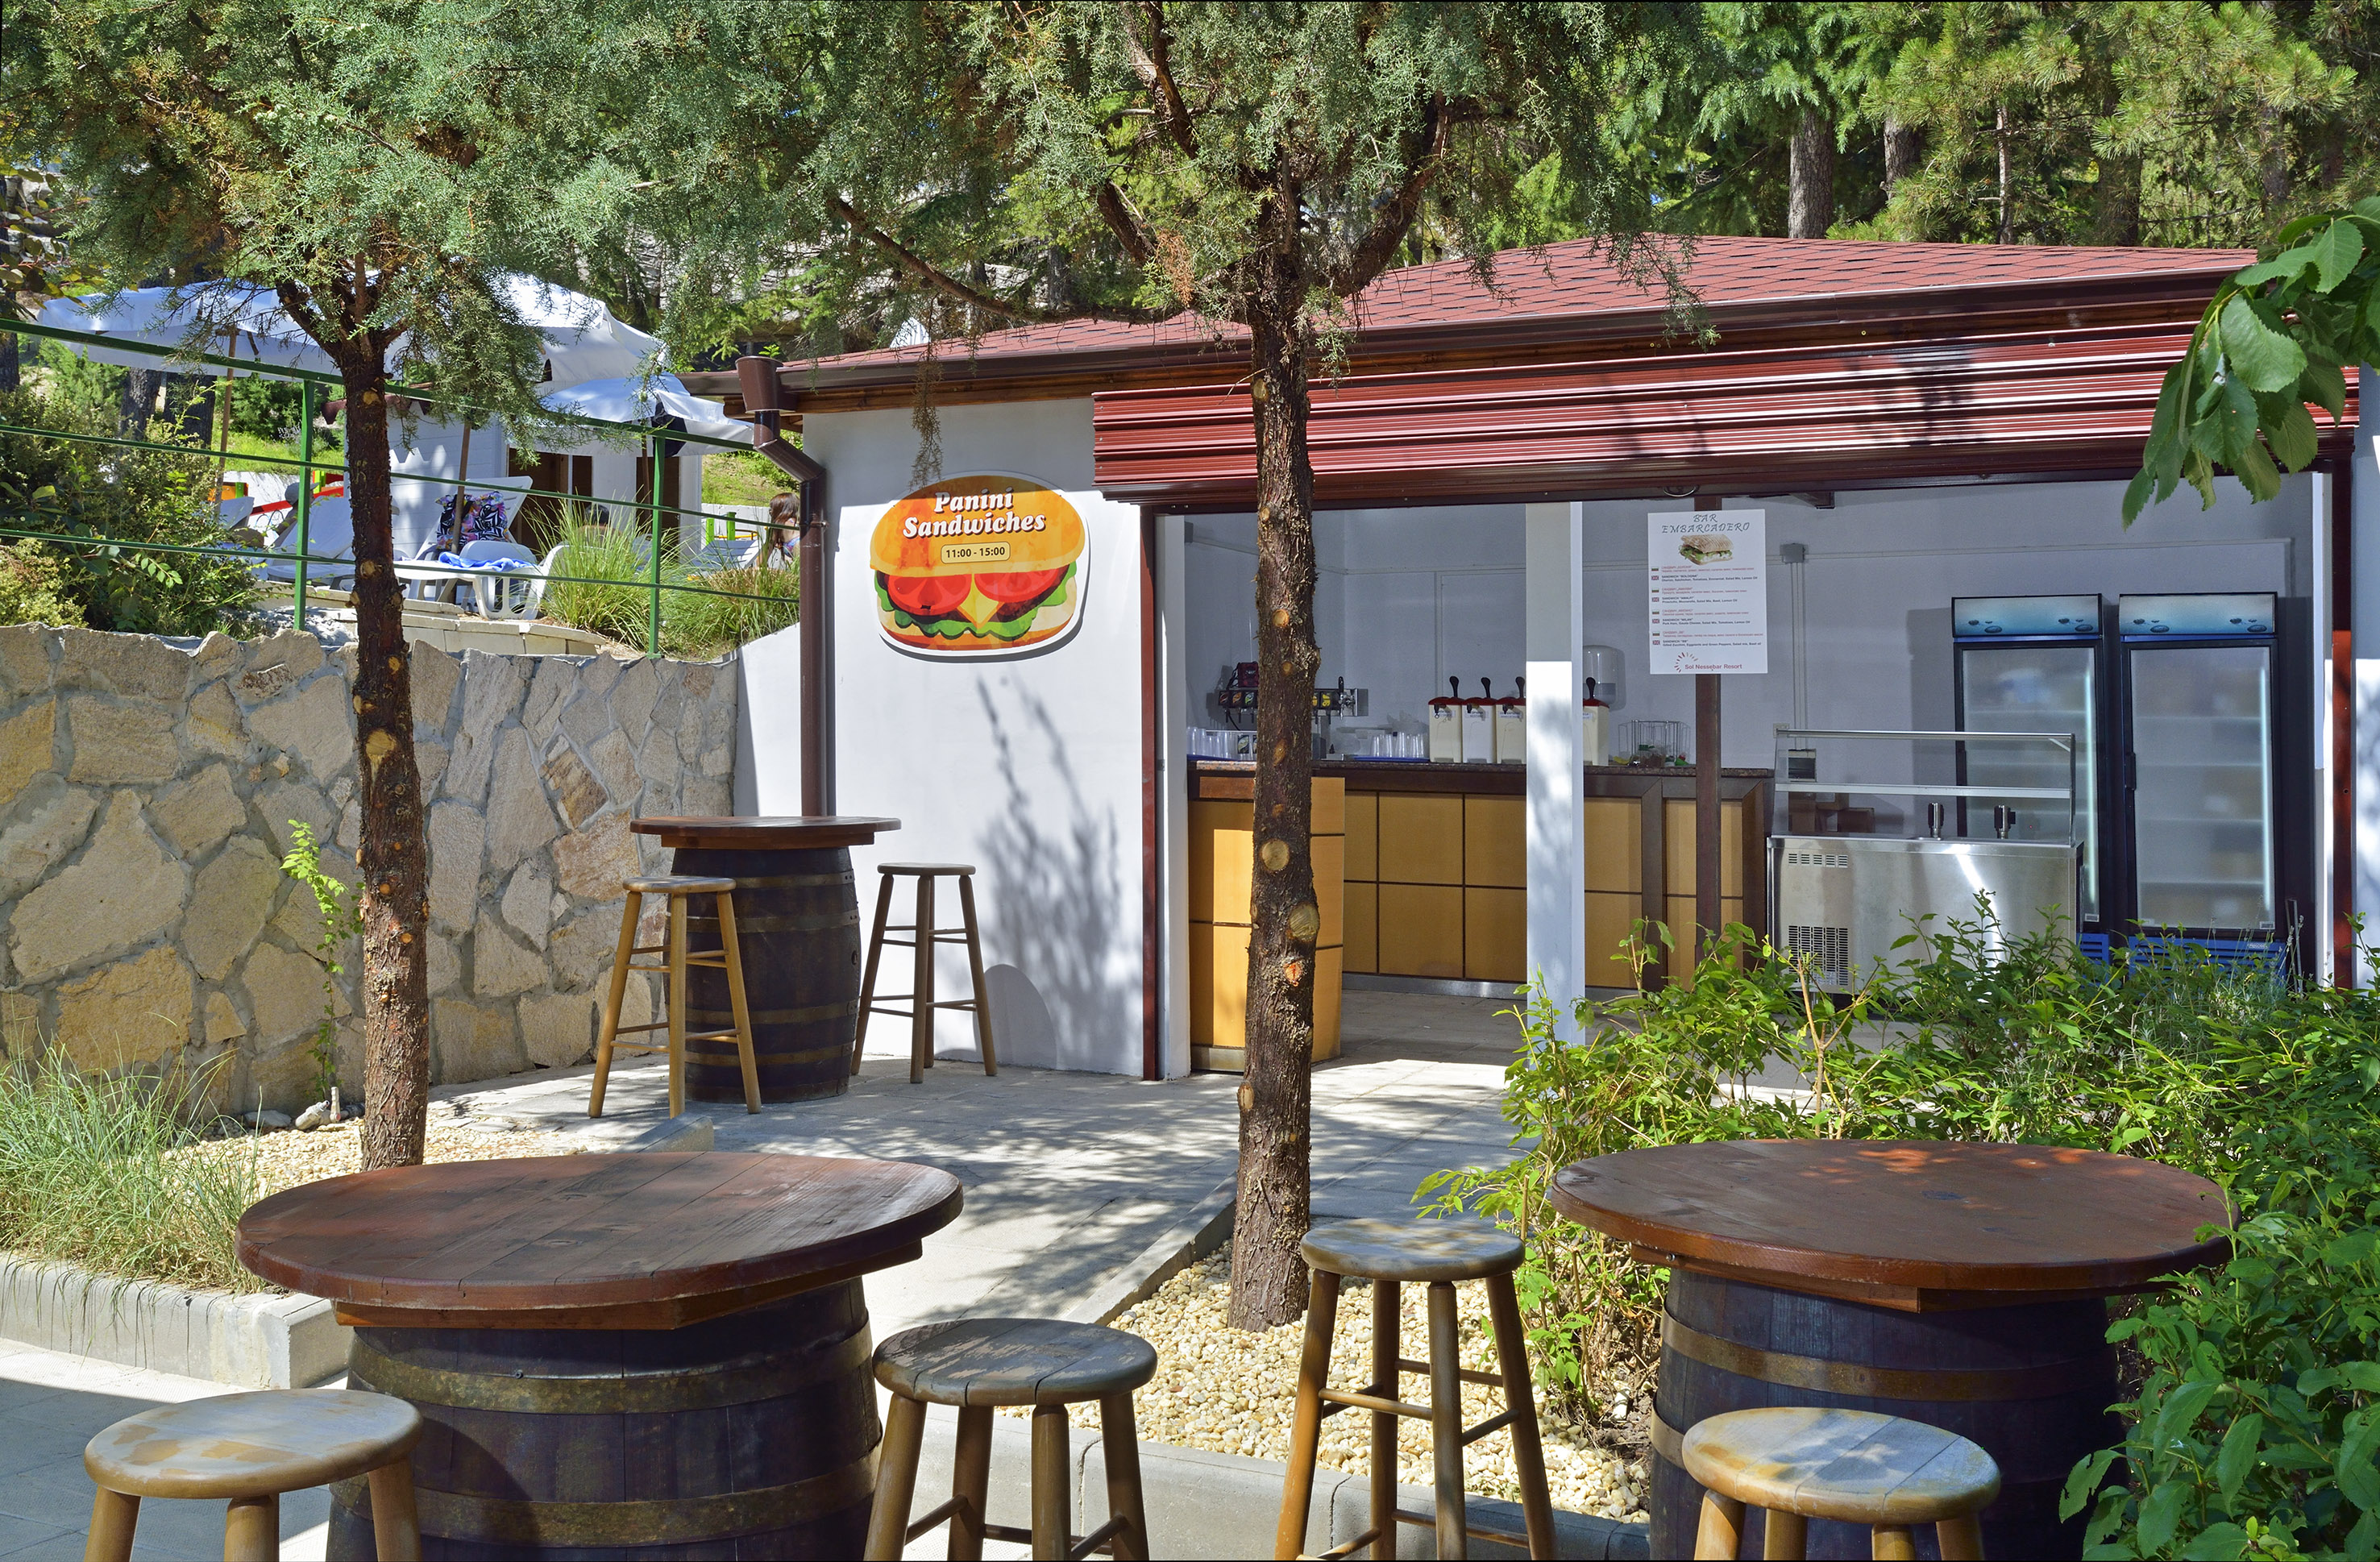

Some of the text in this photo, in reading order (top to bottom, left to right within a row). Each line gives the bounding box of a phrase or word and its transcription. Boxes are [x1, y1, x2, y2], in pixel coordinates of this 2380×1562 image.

[933, 487, 1014, 513] Panini
[902, 510, 1047, 538] Sandwiches
[1693, 513, 1718, 523] BAR
[1662, 522, 1750, 534] EMBARCADERO
[946, 549, 971, 558] 11:00
[979, 547, 1005, 556] 15:00
